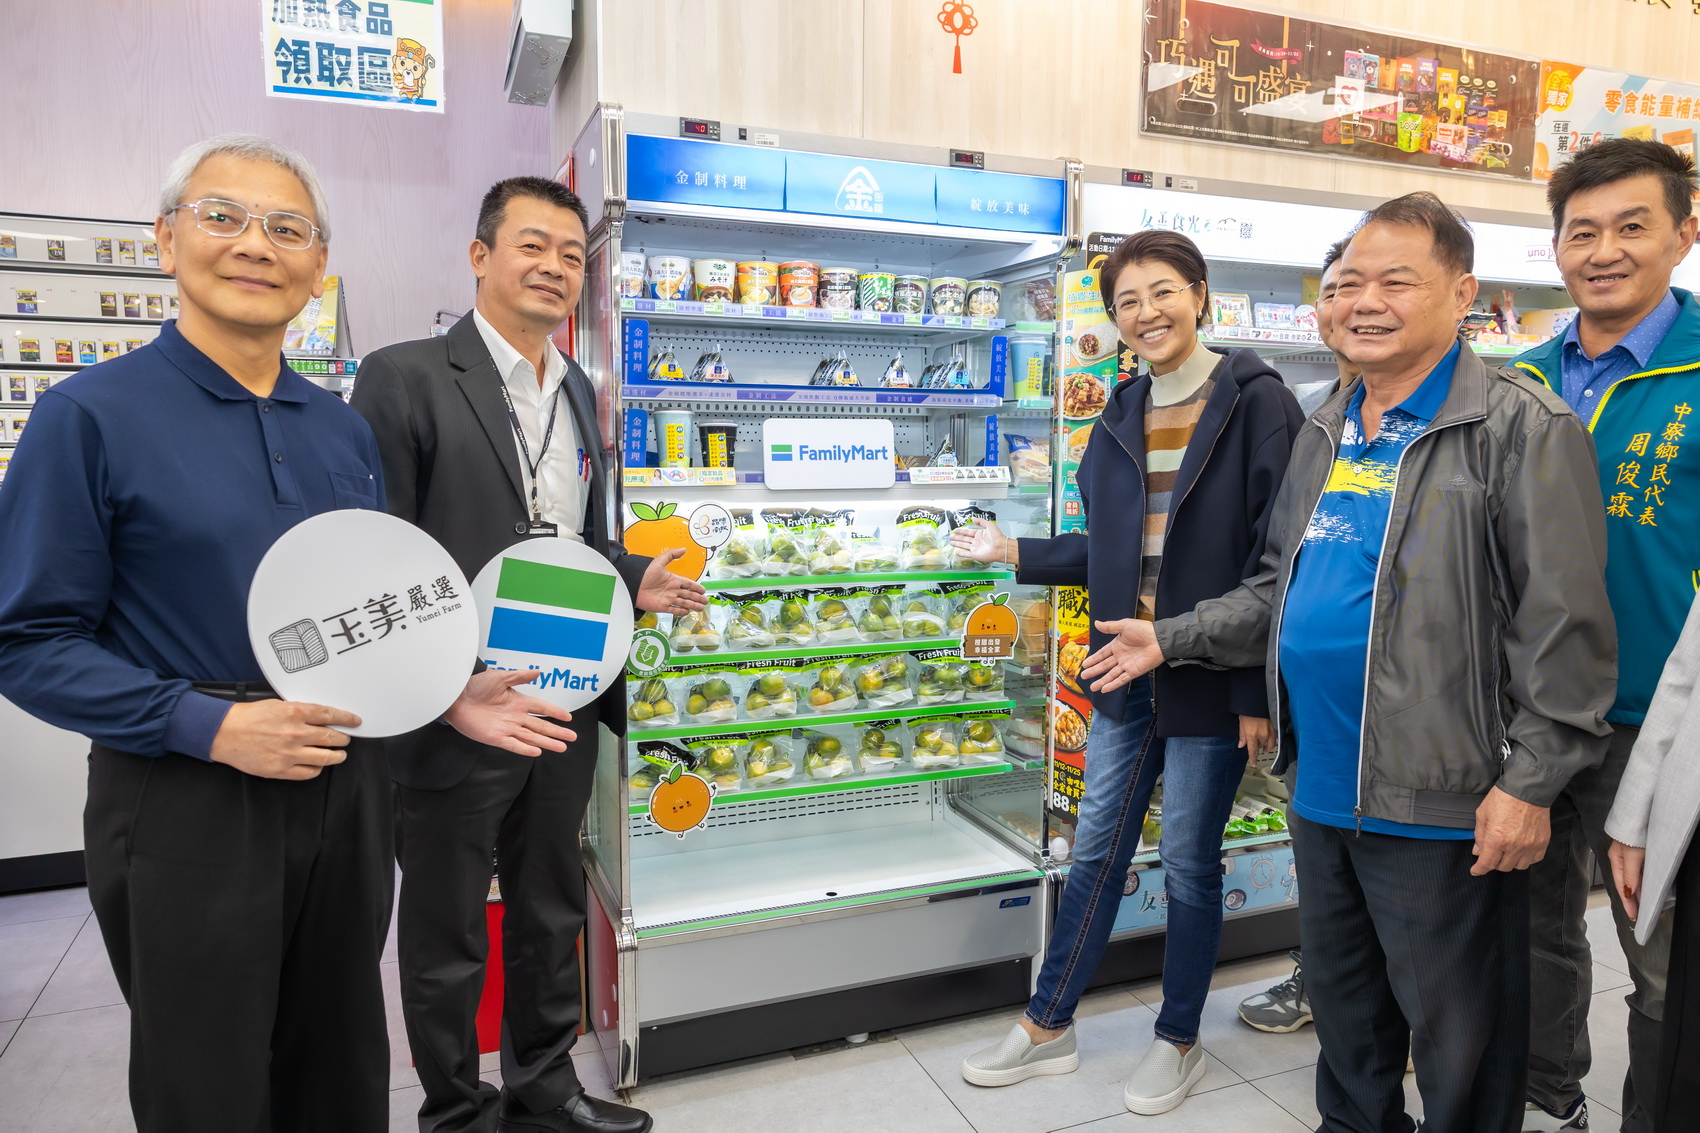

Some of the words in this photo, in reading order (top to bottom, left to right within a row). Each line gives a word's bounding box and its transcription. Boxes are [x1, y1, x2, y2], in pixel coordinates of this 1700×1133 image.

[273, 37, 394, 94] 領取區
[1549, 75, 1573, 91] 全家
[1546, 90, 1569, 107] 獨家
[1553, 122, 1569, 133] 任選
[675, 170, 747, 190] 金制料理
[844, 178, 875, 212] 金
[970, 198, 1030, 216] 綻放美味
[1088, 243, 1116, 252] 活動日期:11
[1099, 235, 1127, 244] FamilyM
[633, 327, 643, 373] 金制料理
[1119, 349, 1138, 371] 享
[630, 416, 642, 462] 金制料理
[799, 445, 889, 463] FamilyMart
[1636, 402, 1693, 527] 中寮鄉民代表
[1606, 432, 1652, 518] 周俊霖
[416, 609, 442, 625] Yumei
[442, 602, 462, 618] Farm
[747, 659, 773, 668] Fresh
[774, 658, 797, 667] Fruit
[918, 649, 943, 661] Fresh
[944, 647, 963, 658] Frui
[484, 659, 600, 692] FyMart
[1054, 760, 1081, 776] 11/12-11/25
